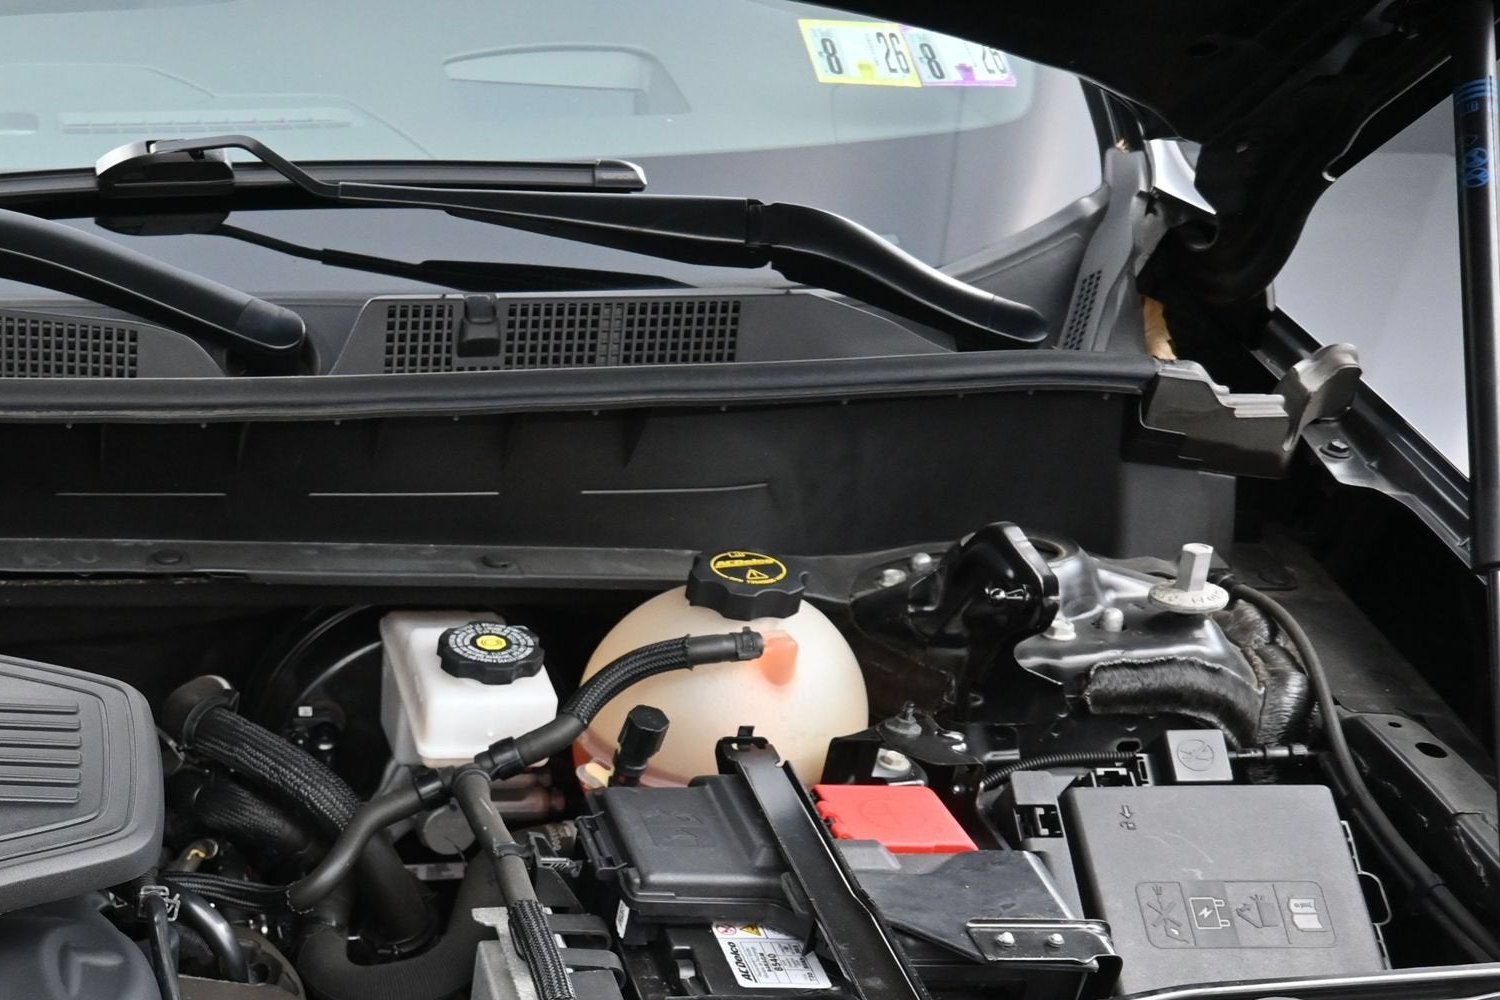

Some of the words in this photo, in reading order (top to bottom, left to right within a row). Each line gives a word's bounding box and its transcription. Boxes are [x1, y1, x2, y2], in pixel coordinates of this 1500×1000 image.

[821, 37, 843, 75] 8
[876, 31, 910, 74] 26
[919, 42, 945, 80] 8
[727, 941, 753, 982] ACDelco
